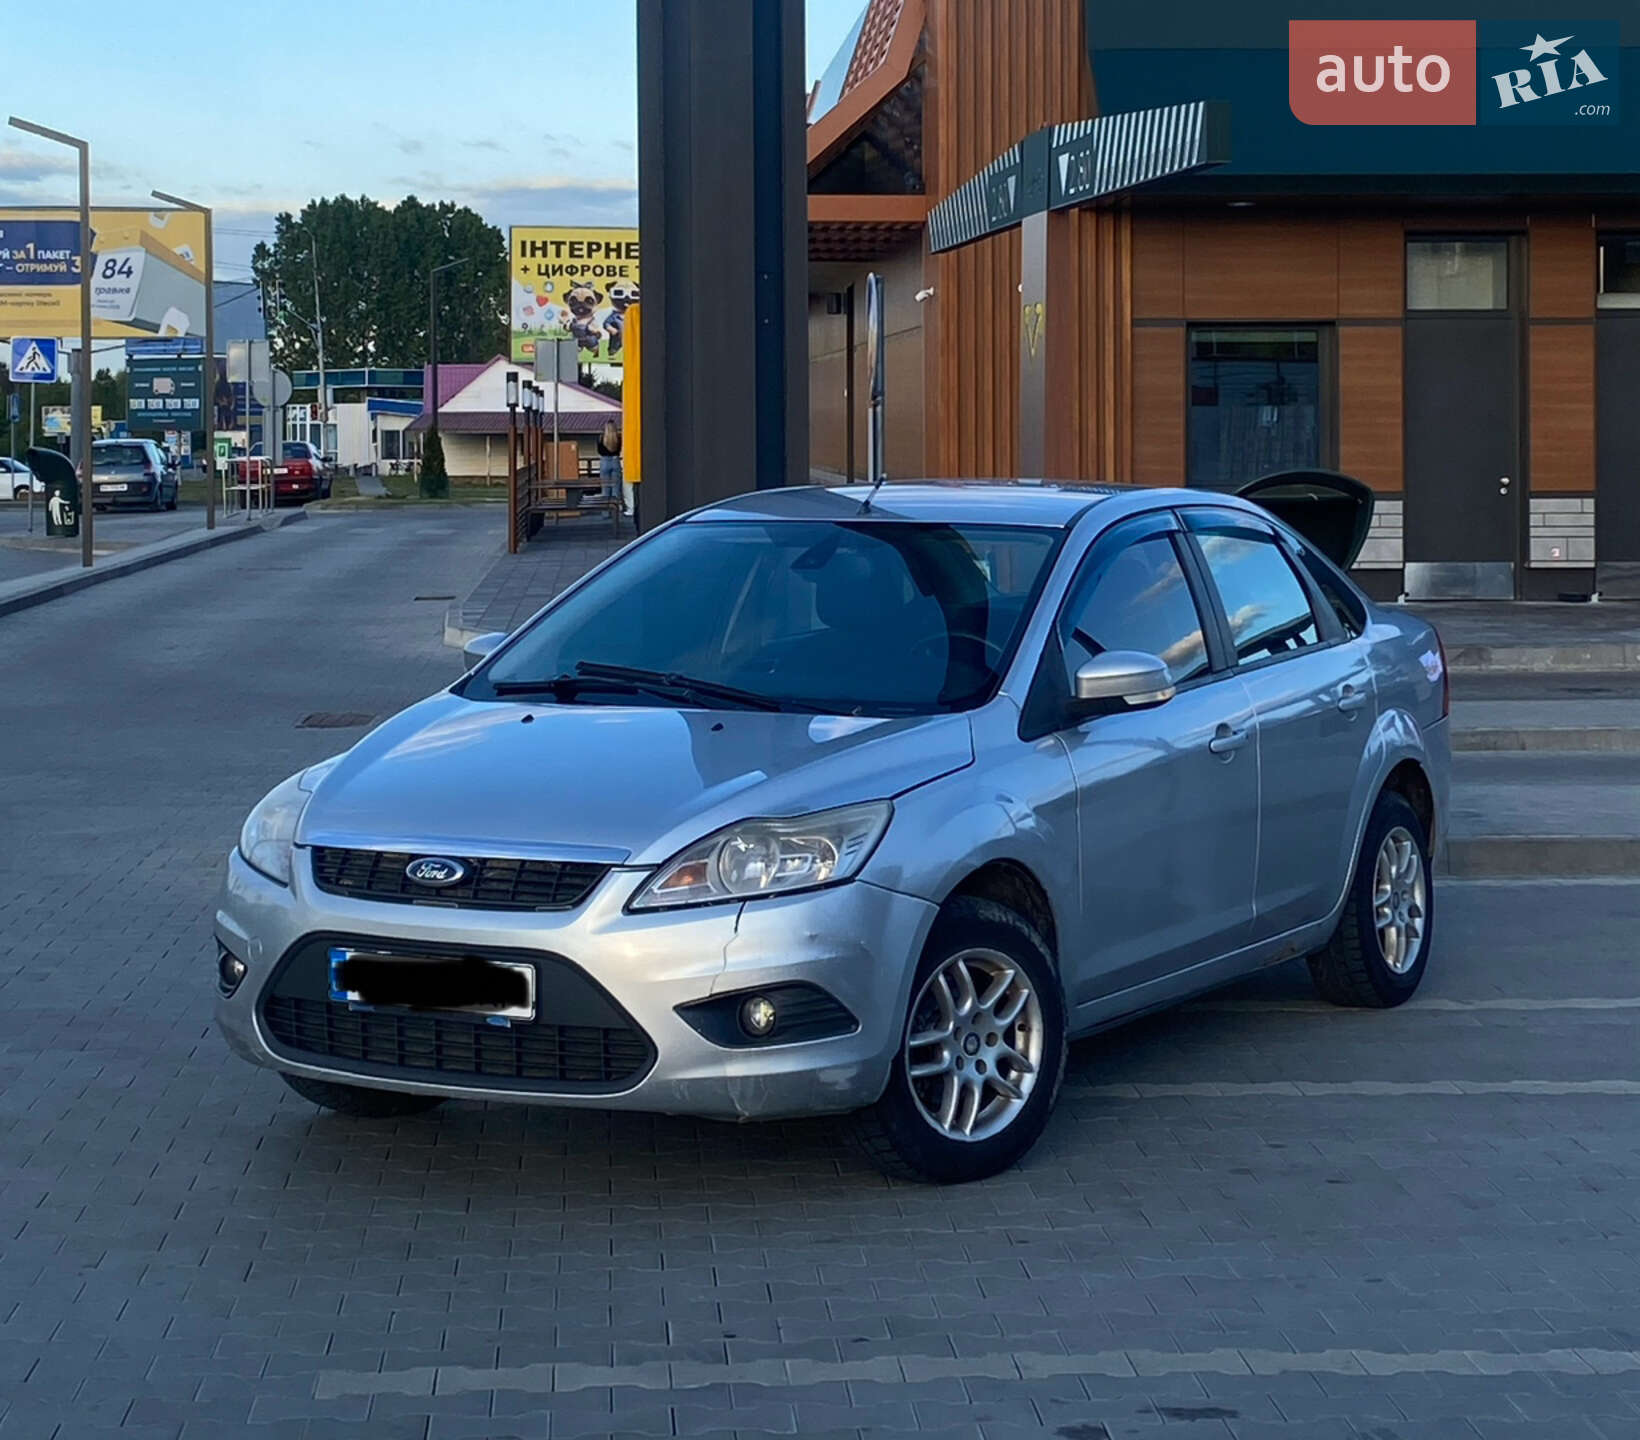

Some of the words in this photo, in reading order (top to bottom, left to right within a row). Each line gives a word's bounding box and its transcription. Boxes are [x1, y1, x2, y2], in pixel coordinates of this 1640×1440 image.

[25, 242, 36, 260] 1
[37, 249, 72, 260] ПАКЕТ
[520, 240, 639, 260] ІНТЕРНЕ
[15, 261, 68, 273] ОТРИМУЙ
[102, 256, 134, 279] 84
[537, 264, 630, 279] ЦИФРОВЕ
[416, 863, 449, 880] Ford
